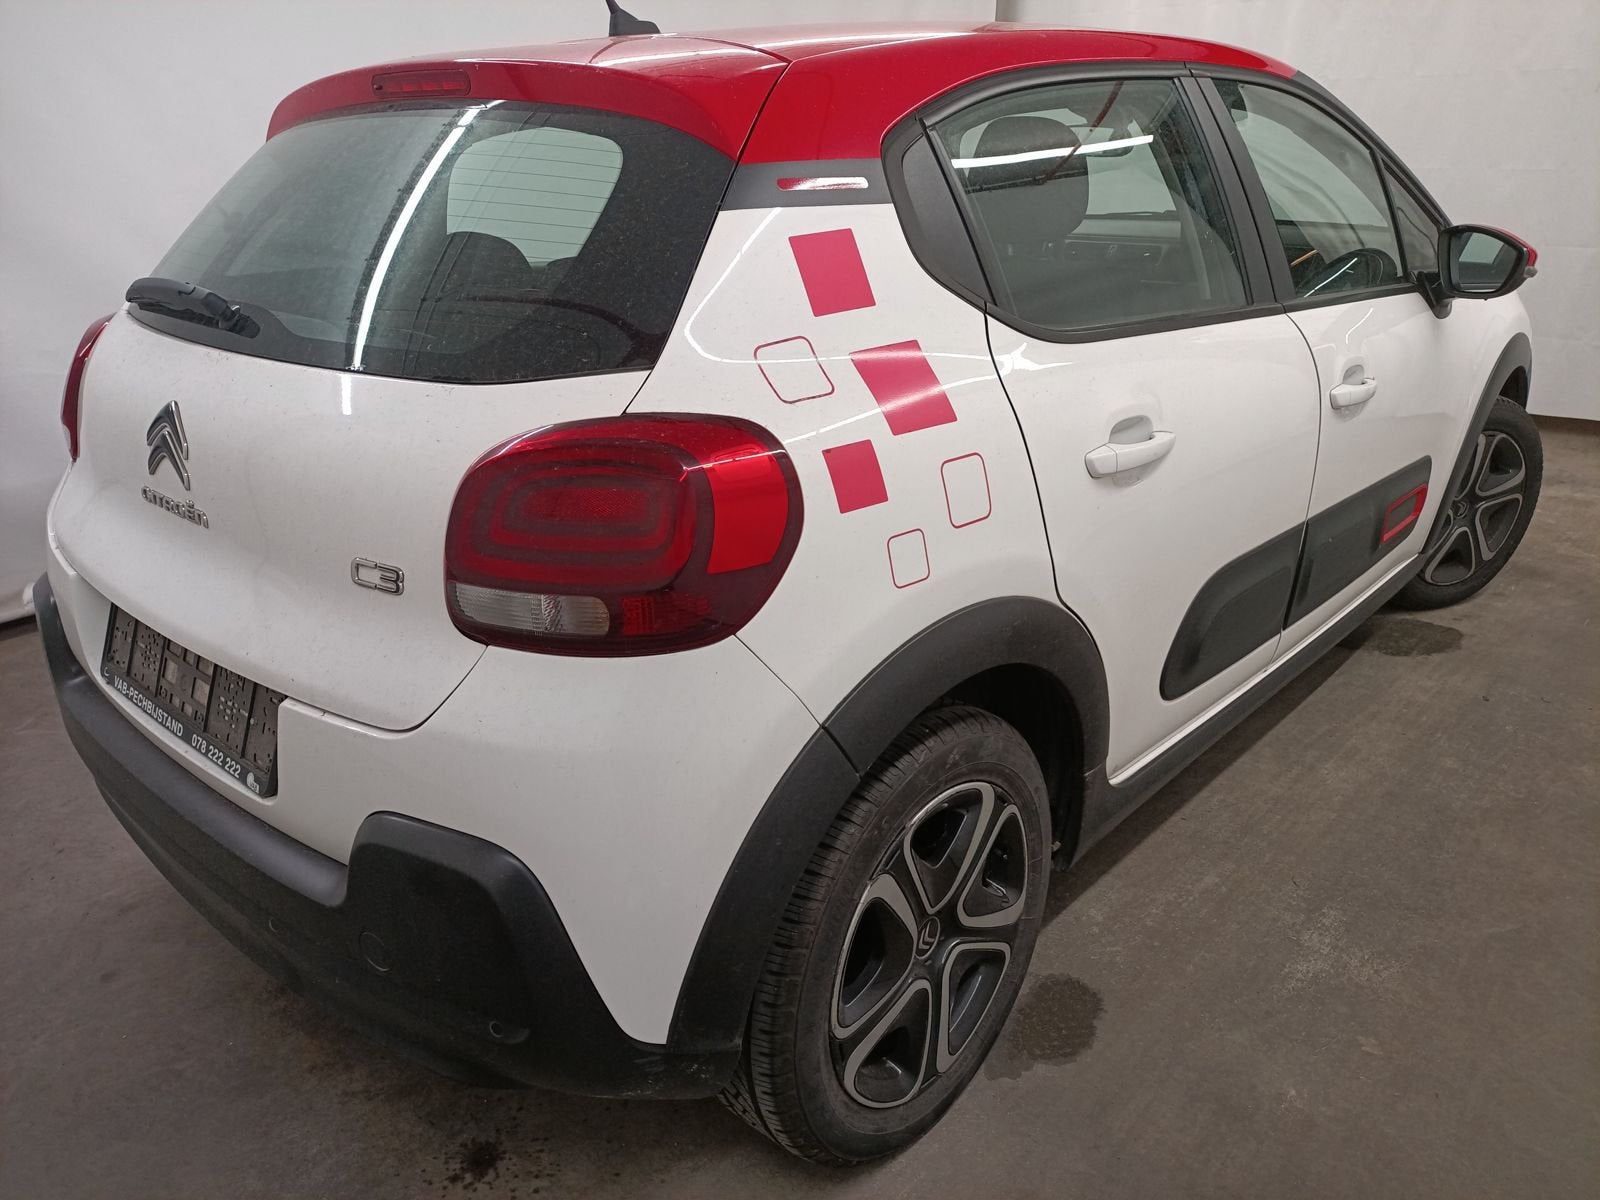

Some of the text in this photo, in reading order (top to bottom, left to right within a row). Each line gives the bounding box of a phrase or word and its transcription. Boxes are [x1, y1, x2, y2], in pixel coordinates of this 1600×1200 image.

[350, 557, 404, 595] C3
[113, 675, 241, 779] VAB-PECHBIJSTAND 078 222 222
